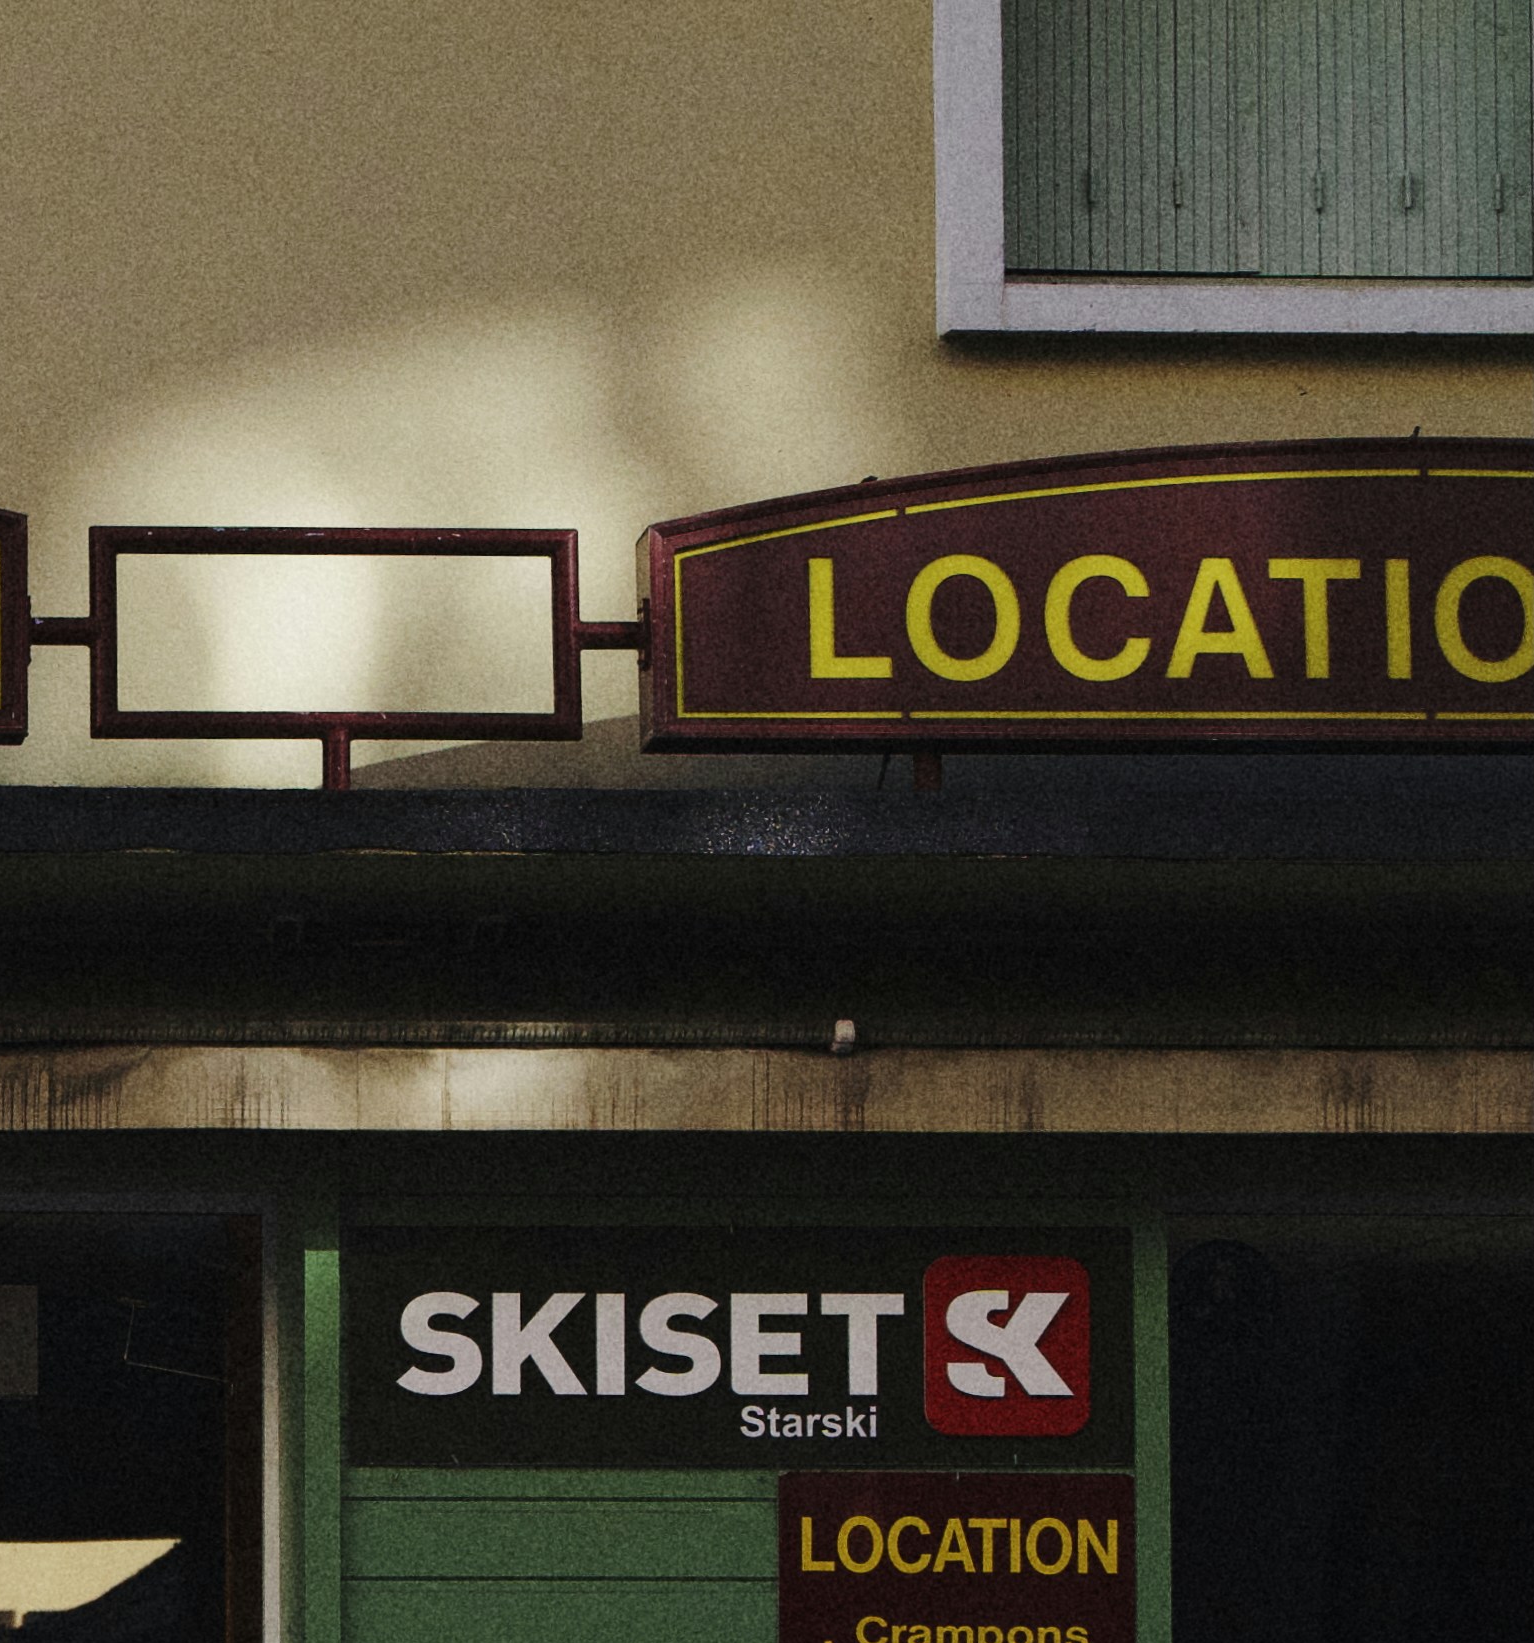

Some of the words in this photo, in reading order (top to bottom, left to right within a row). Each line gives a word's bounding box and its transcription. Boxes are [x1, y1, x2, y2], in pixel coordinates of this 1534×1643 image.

[807, 553, 1534, 683] LOCATIO
[396, 1290, 905, 1398] SKISET
[739, 1404, 880, 1440] Starski
[800, 1514, 1119, 1576] LOCATION
